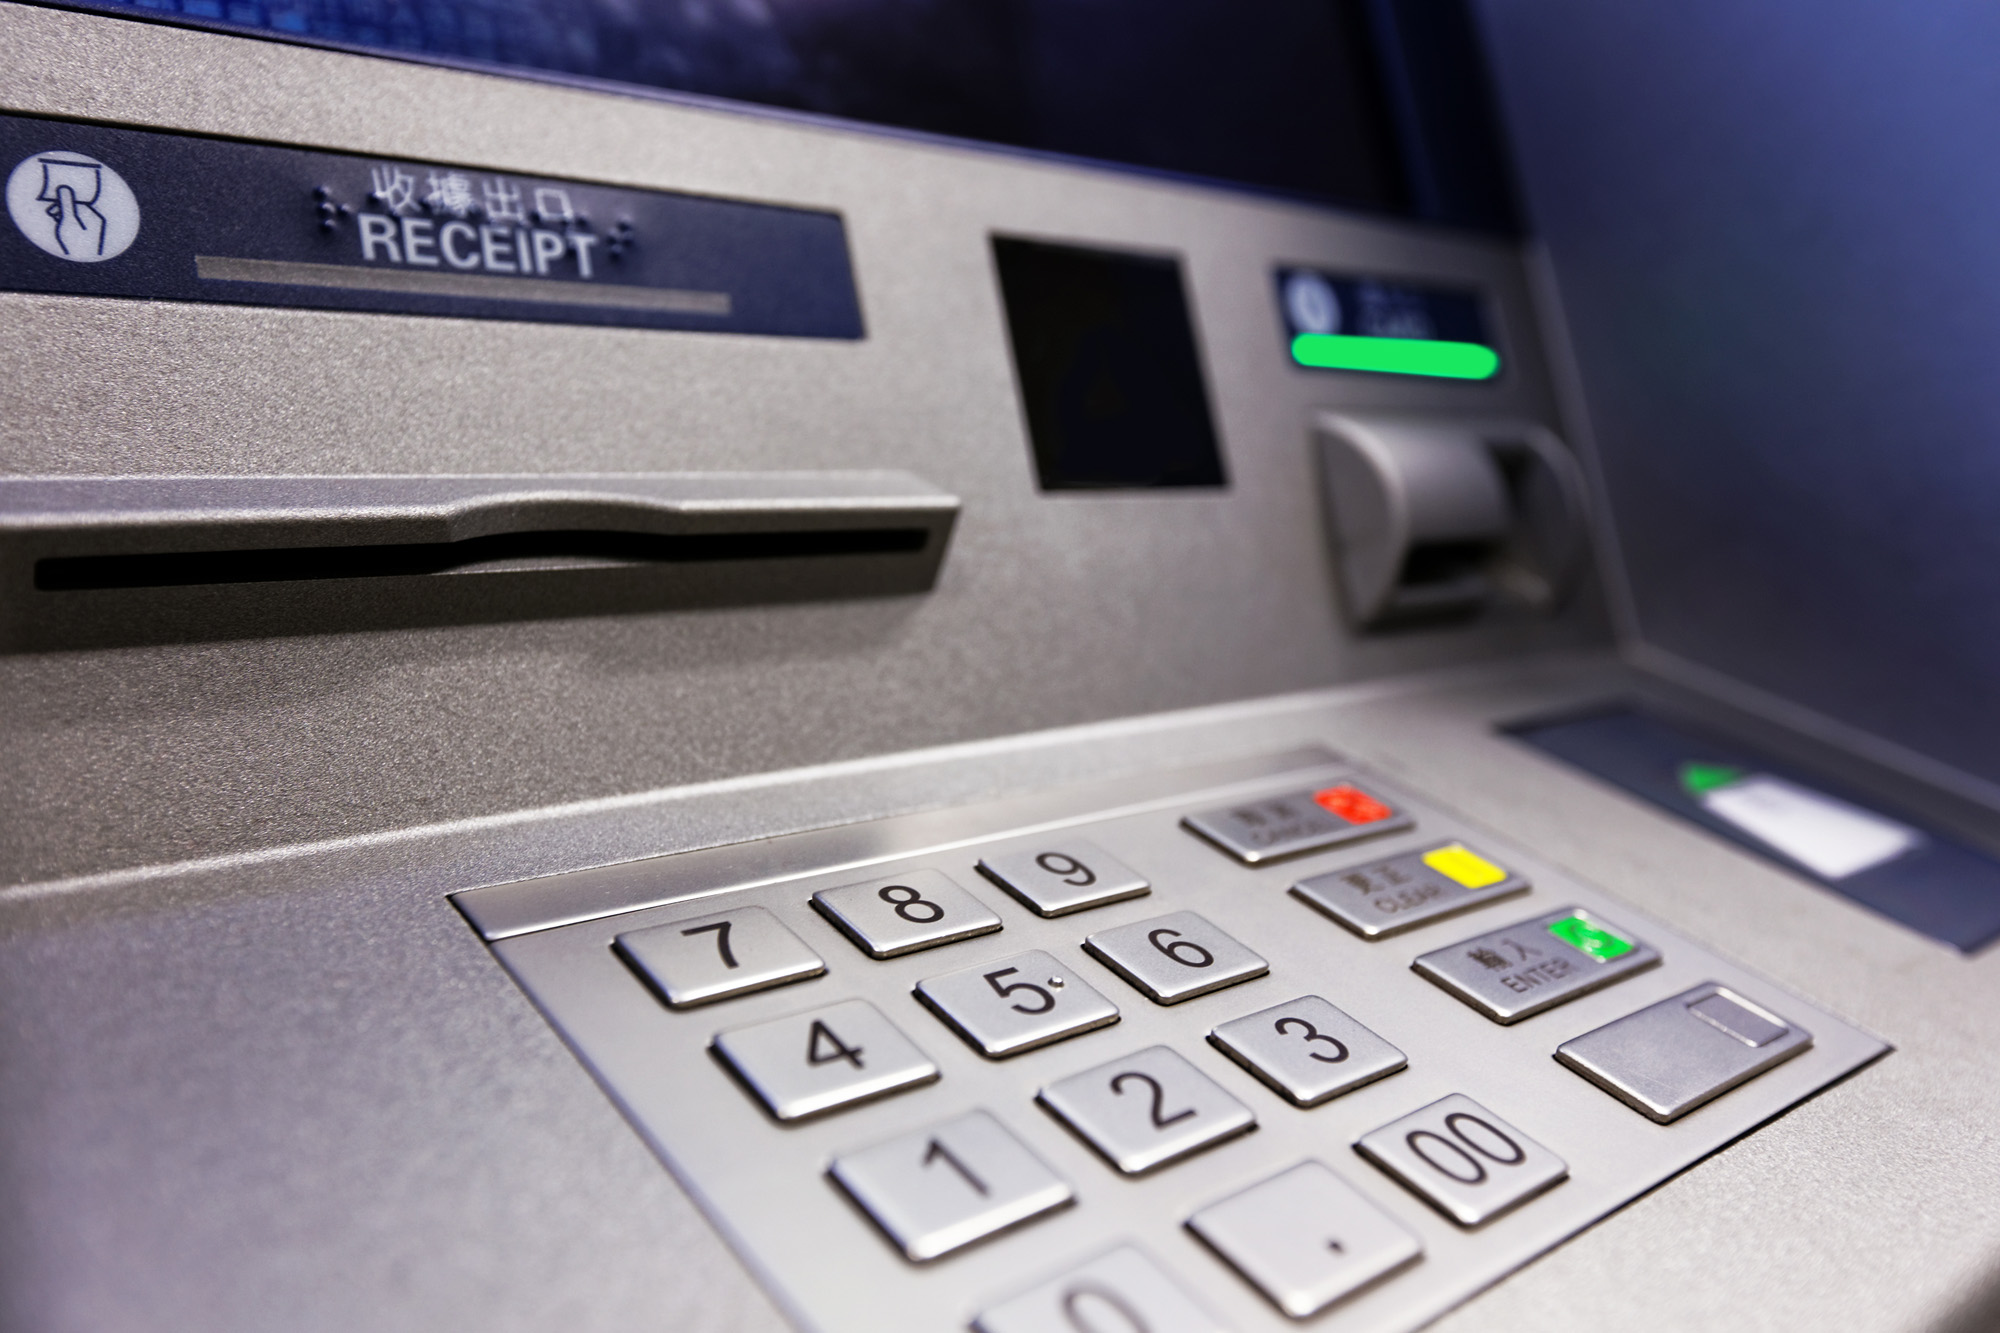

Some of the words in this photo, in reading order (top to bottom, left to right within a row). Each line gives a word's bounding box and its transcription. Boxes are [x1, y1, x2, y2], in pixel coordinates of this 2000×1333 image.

[357, 212, 596, 279] RECEIPT
[1035, 852, 1096, 887] 9
[878, 885, 945, 923] 8
[681, 921, 739, 969] 7
[1147, 928, 1214, 968] 6
[982, 966, 1056, 1015] 5
[1500, 956, 1581, 993] ENTER
[807, 1019, 865, 1069] 4
[1274, 1017, 1350, 1064] 3
[1110, 1072, 1197, 1130] 2
[922, 1138, 990, 1197] 1
[1405, 1112, 1526, 1186] 00
